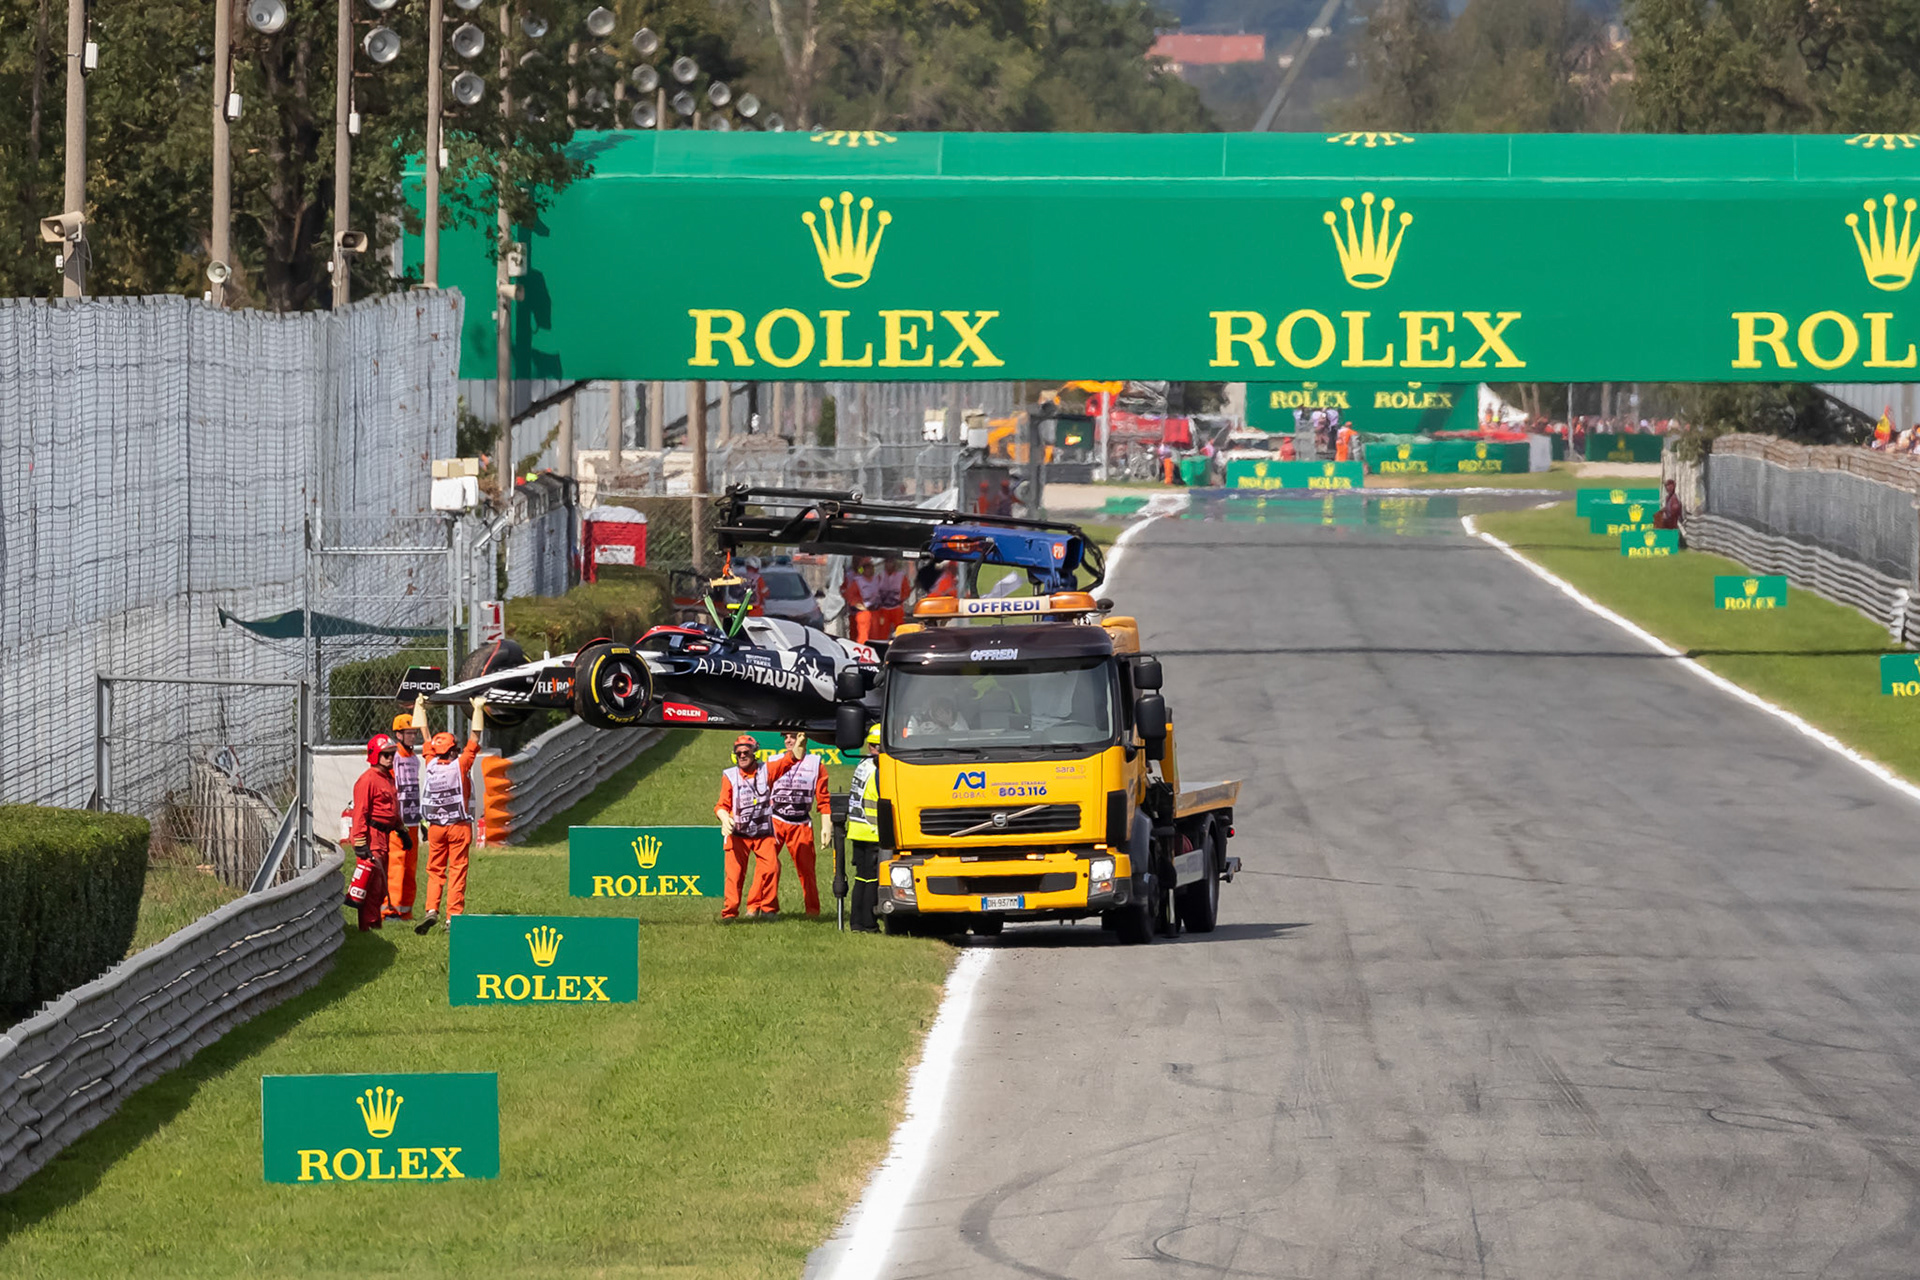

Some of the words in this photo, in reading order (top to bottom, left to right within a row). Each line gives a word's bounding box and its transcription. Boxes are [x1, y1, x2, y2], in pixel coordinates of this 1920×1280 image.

[689, 309, 1004, 368] ROLEX
[1210, 309, 1526, 369] ROLEX
[1731, 310, 1918, 370] ROL
[1270, 390, 1350, 409] ROLEX
[1373, 391, 1453, 409] ROLEX
[968, 600, 1040, 614] OFFREDI
[1725, 597, 1776, 610] ROLEX
[970, 648, 1019, 660] OFFREDI
[694, 657, 804, 692] ALPHATAURI
[676, 709, 702, 717] ORLEN
[952, 791, 986, 799] GLOBAL
[592, 875, 703, 897] ROLEX
[476, 974, 610, 1002] ROLEX
[297, 1147, 465, 1182] ROLEX
